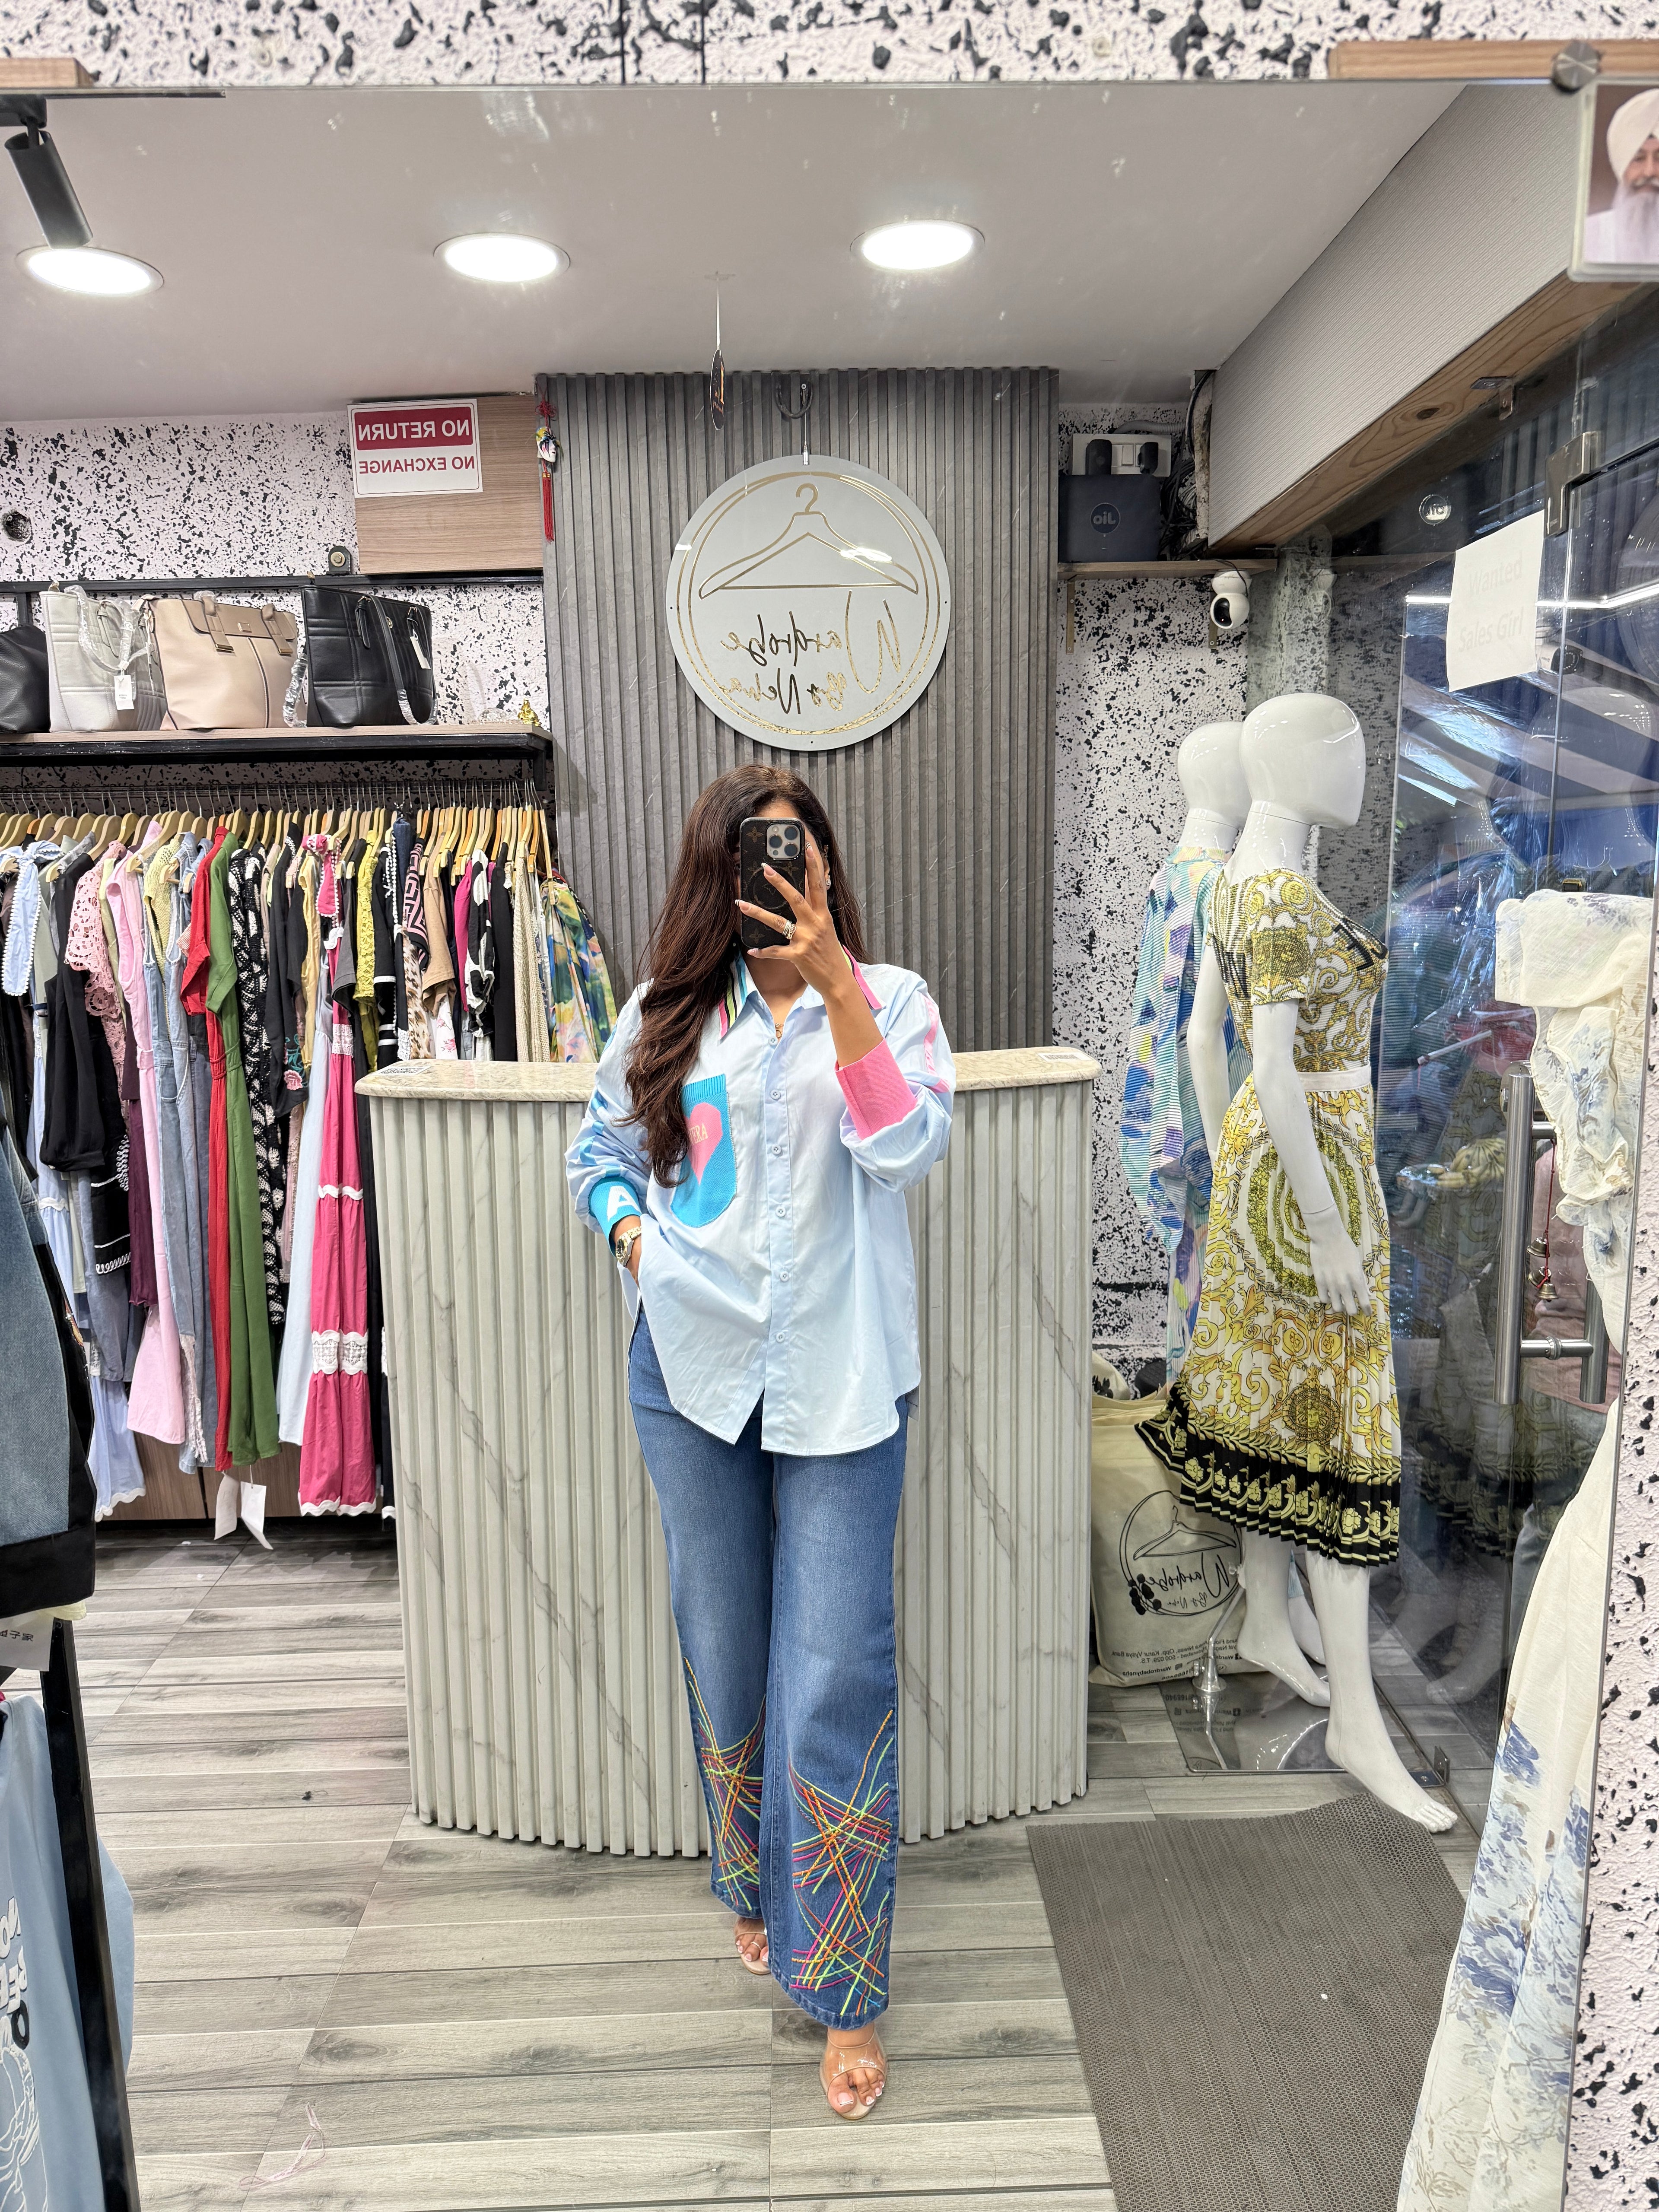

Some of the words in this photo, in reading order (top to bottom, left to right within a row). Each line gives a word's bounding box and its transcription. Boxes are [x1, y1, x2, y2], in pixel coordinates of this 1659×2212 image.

[1469, 550, 1522, 597] Wanted
[1459, 620, 1493, 653] Sales
[1497, 606, 1524, 640] Girl
